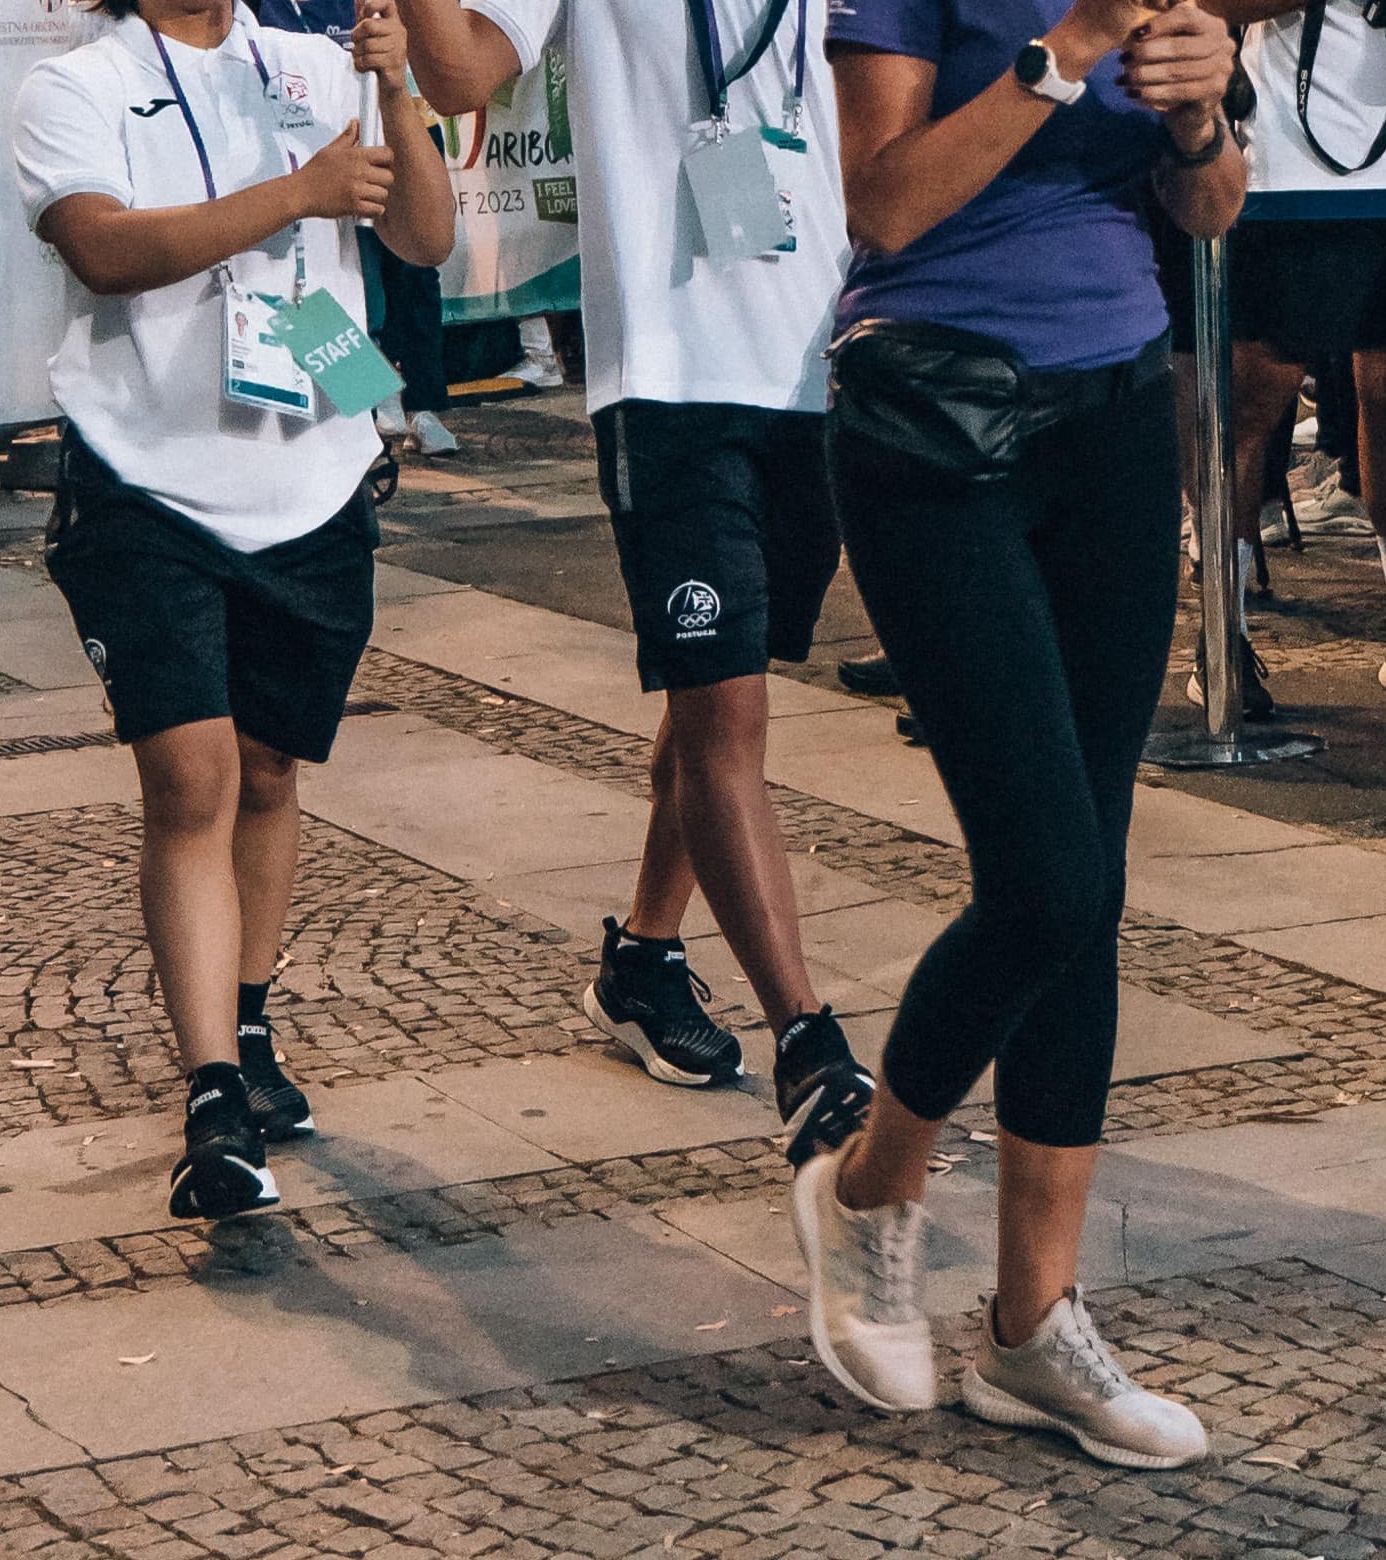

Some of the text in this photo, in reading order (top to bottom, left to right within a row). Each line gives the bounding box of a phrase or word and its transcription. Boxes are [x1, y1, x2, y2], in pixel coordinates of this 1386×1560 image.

[544, 181, 574, 197] FEEL
[476, 190, 525, 214] 2023
[303, 326, 363, 373] STAFF
